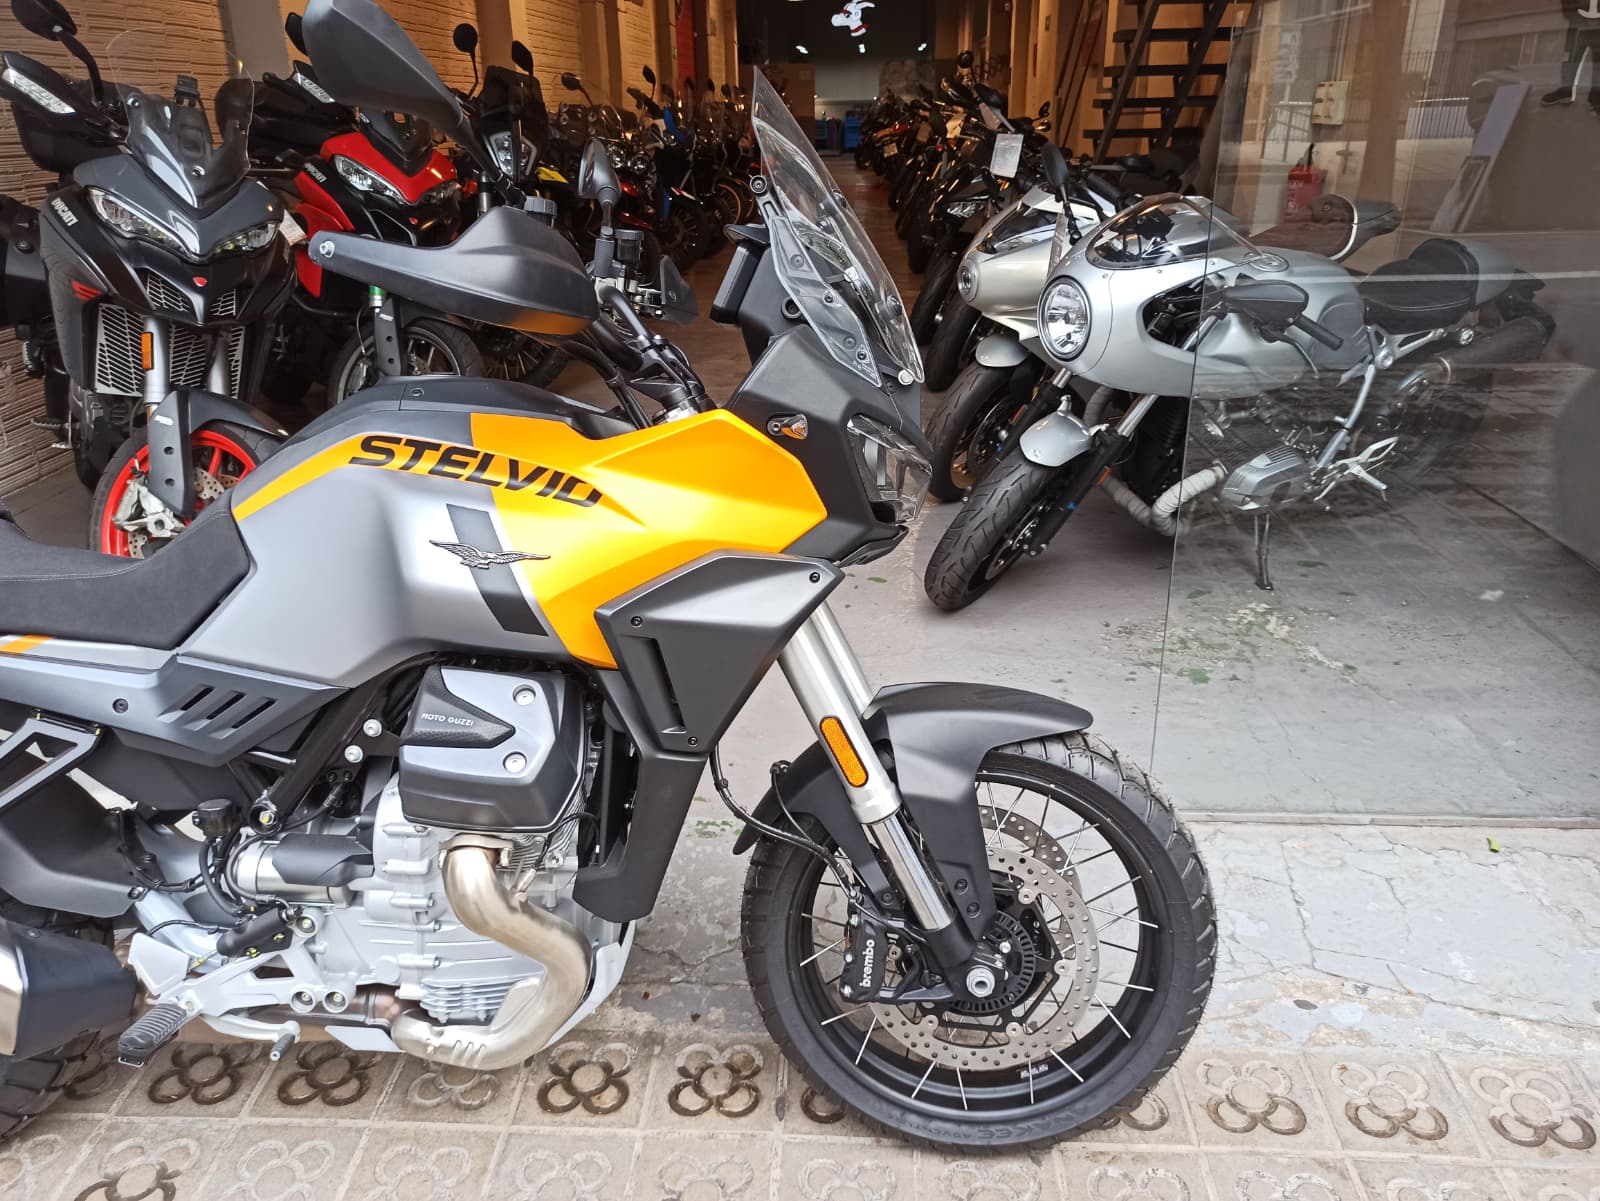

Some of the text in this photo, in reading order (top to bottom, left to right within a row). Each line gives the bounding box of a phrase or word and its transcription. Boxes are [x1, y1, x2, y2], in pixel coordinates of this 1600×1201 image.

[51, 196, 79, 227] DUCATI
[348, 435, 603, 508] STELVIO
[420, 712, 474, 727] MOTO GUZZI
[859, 939, 875, 988] brembo
